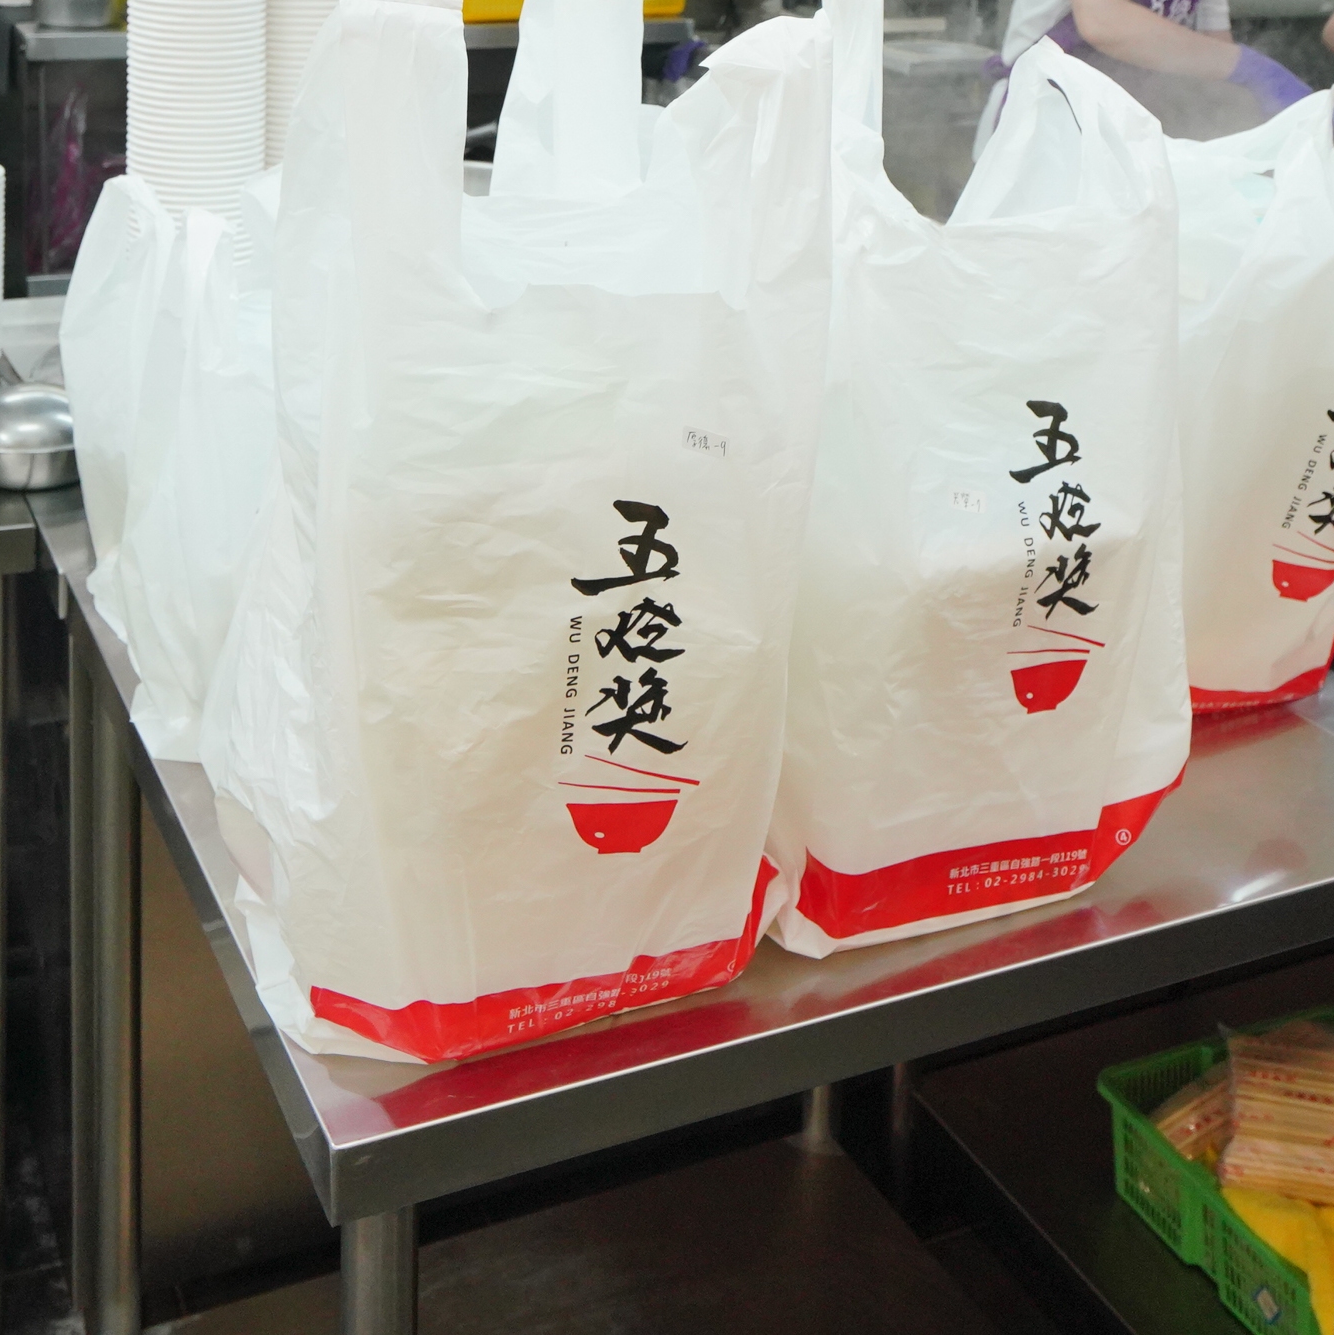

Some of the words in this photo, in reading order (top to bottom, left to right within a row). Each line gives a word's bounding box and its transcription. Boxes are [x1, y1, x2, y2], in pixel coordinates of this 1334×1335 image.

[1297, 459, 1317, 491] DENG
[1017, 501, 1030, 527] WU
[1281, 496, 1302, 529] JIANG
[1023, 537, 1036, 578] DENG
[1012, 586, 1028, 628] JIANG
[568, 615, 583, 644] WU
[565, 653, 580, 698] DENG
[560, 707, 575, 756] JIANG
